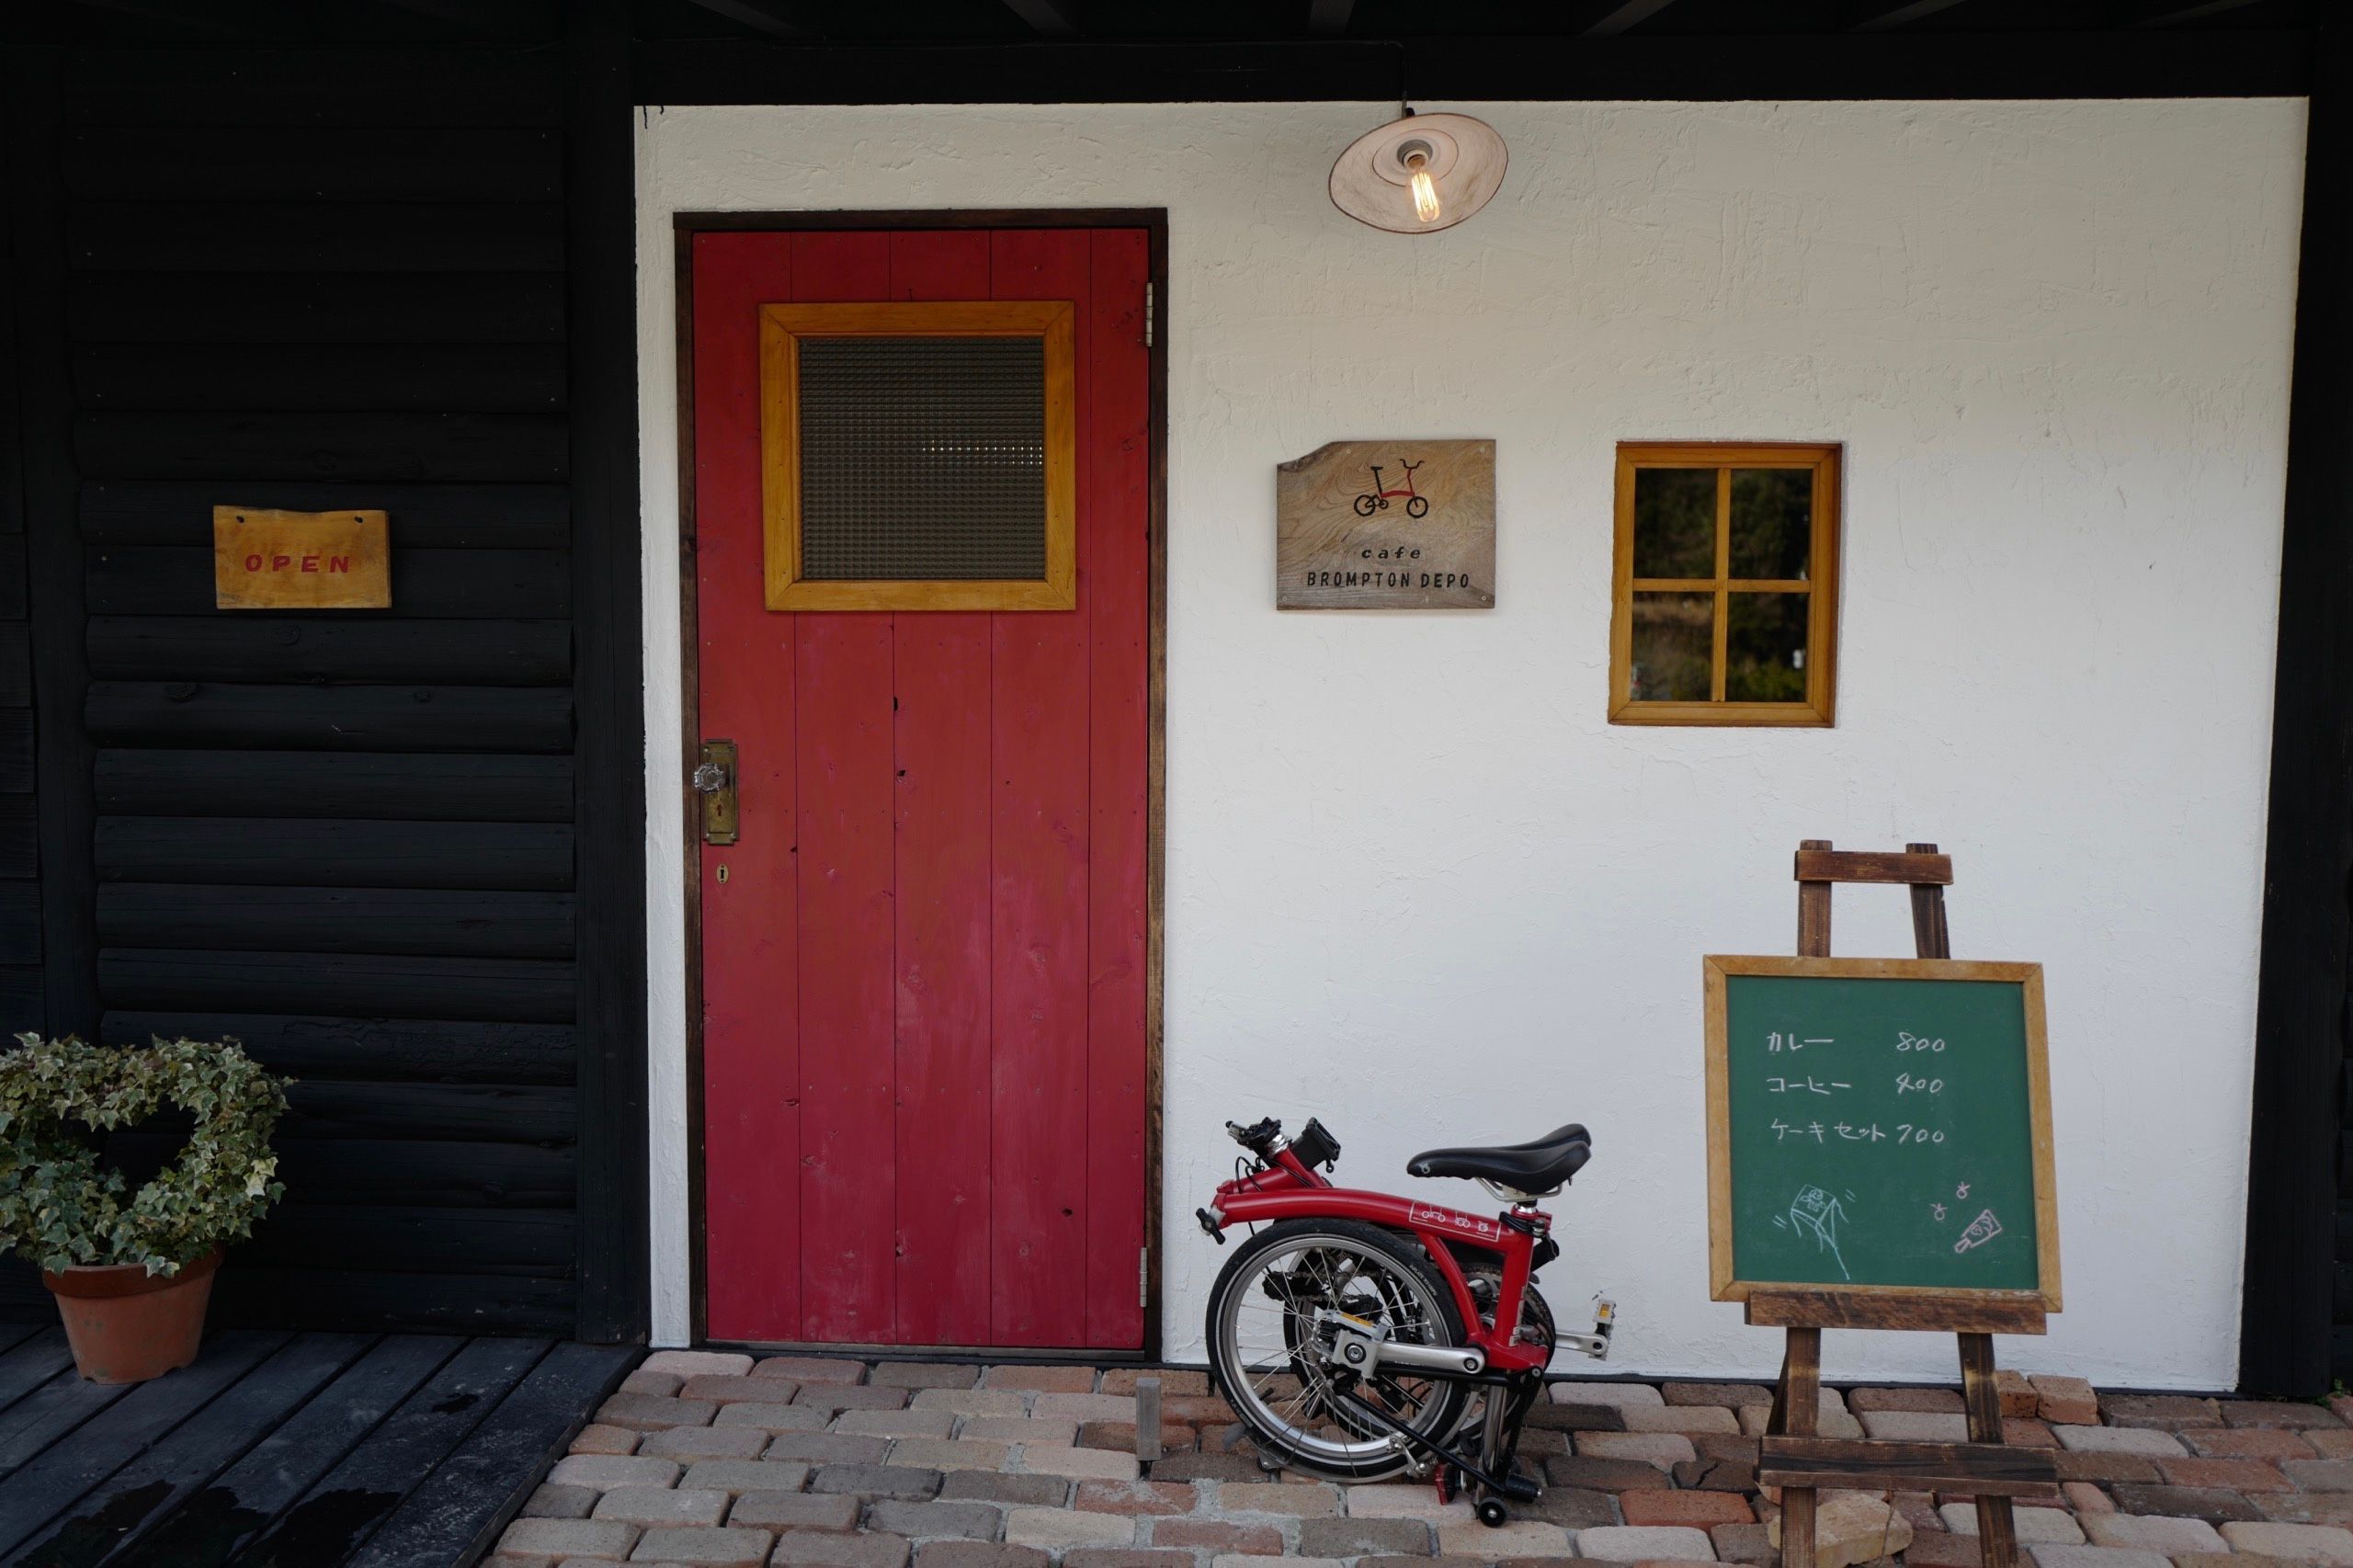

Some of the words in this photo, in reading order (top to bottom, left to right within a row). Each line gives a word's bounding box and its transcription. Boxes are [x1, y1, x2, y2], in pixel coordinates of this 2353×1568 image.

[1361, 546, 1421, 559] cafe
[245, 554, 349, 574] OPEN
[1307, 572, 1410, 588] BROMPTON
[1420, 574, 1470, 588] DEPO
[1767, 1031, 1834, 1051] カレー
[1896, 1031, 1946, 1051] 800
[1767, 1075, 1851, 1095] コーヒー
[1895, 1072, 1943, 1095] 400
[1896, 1124, 1945, 1144] 700
